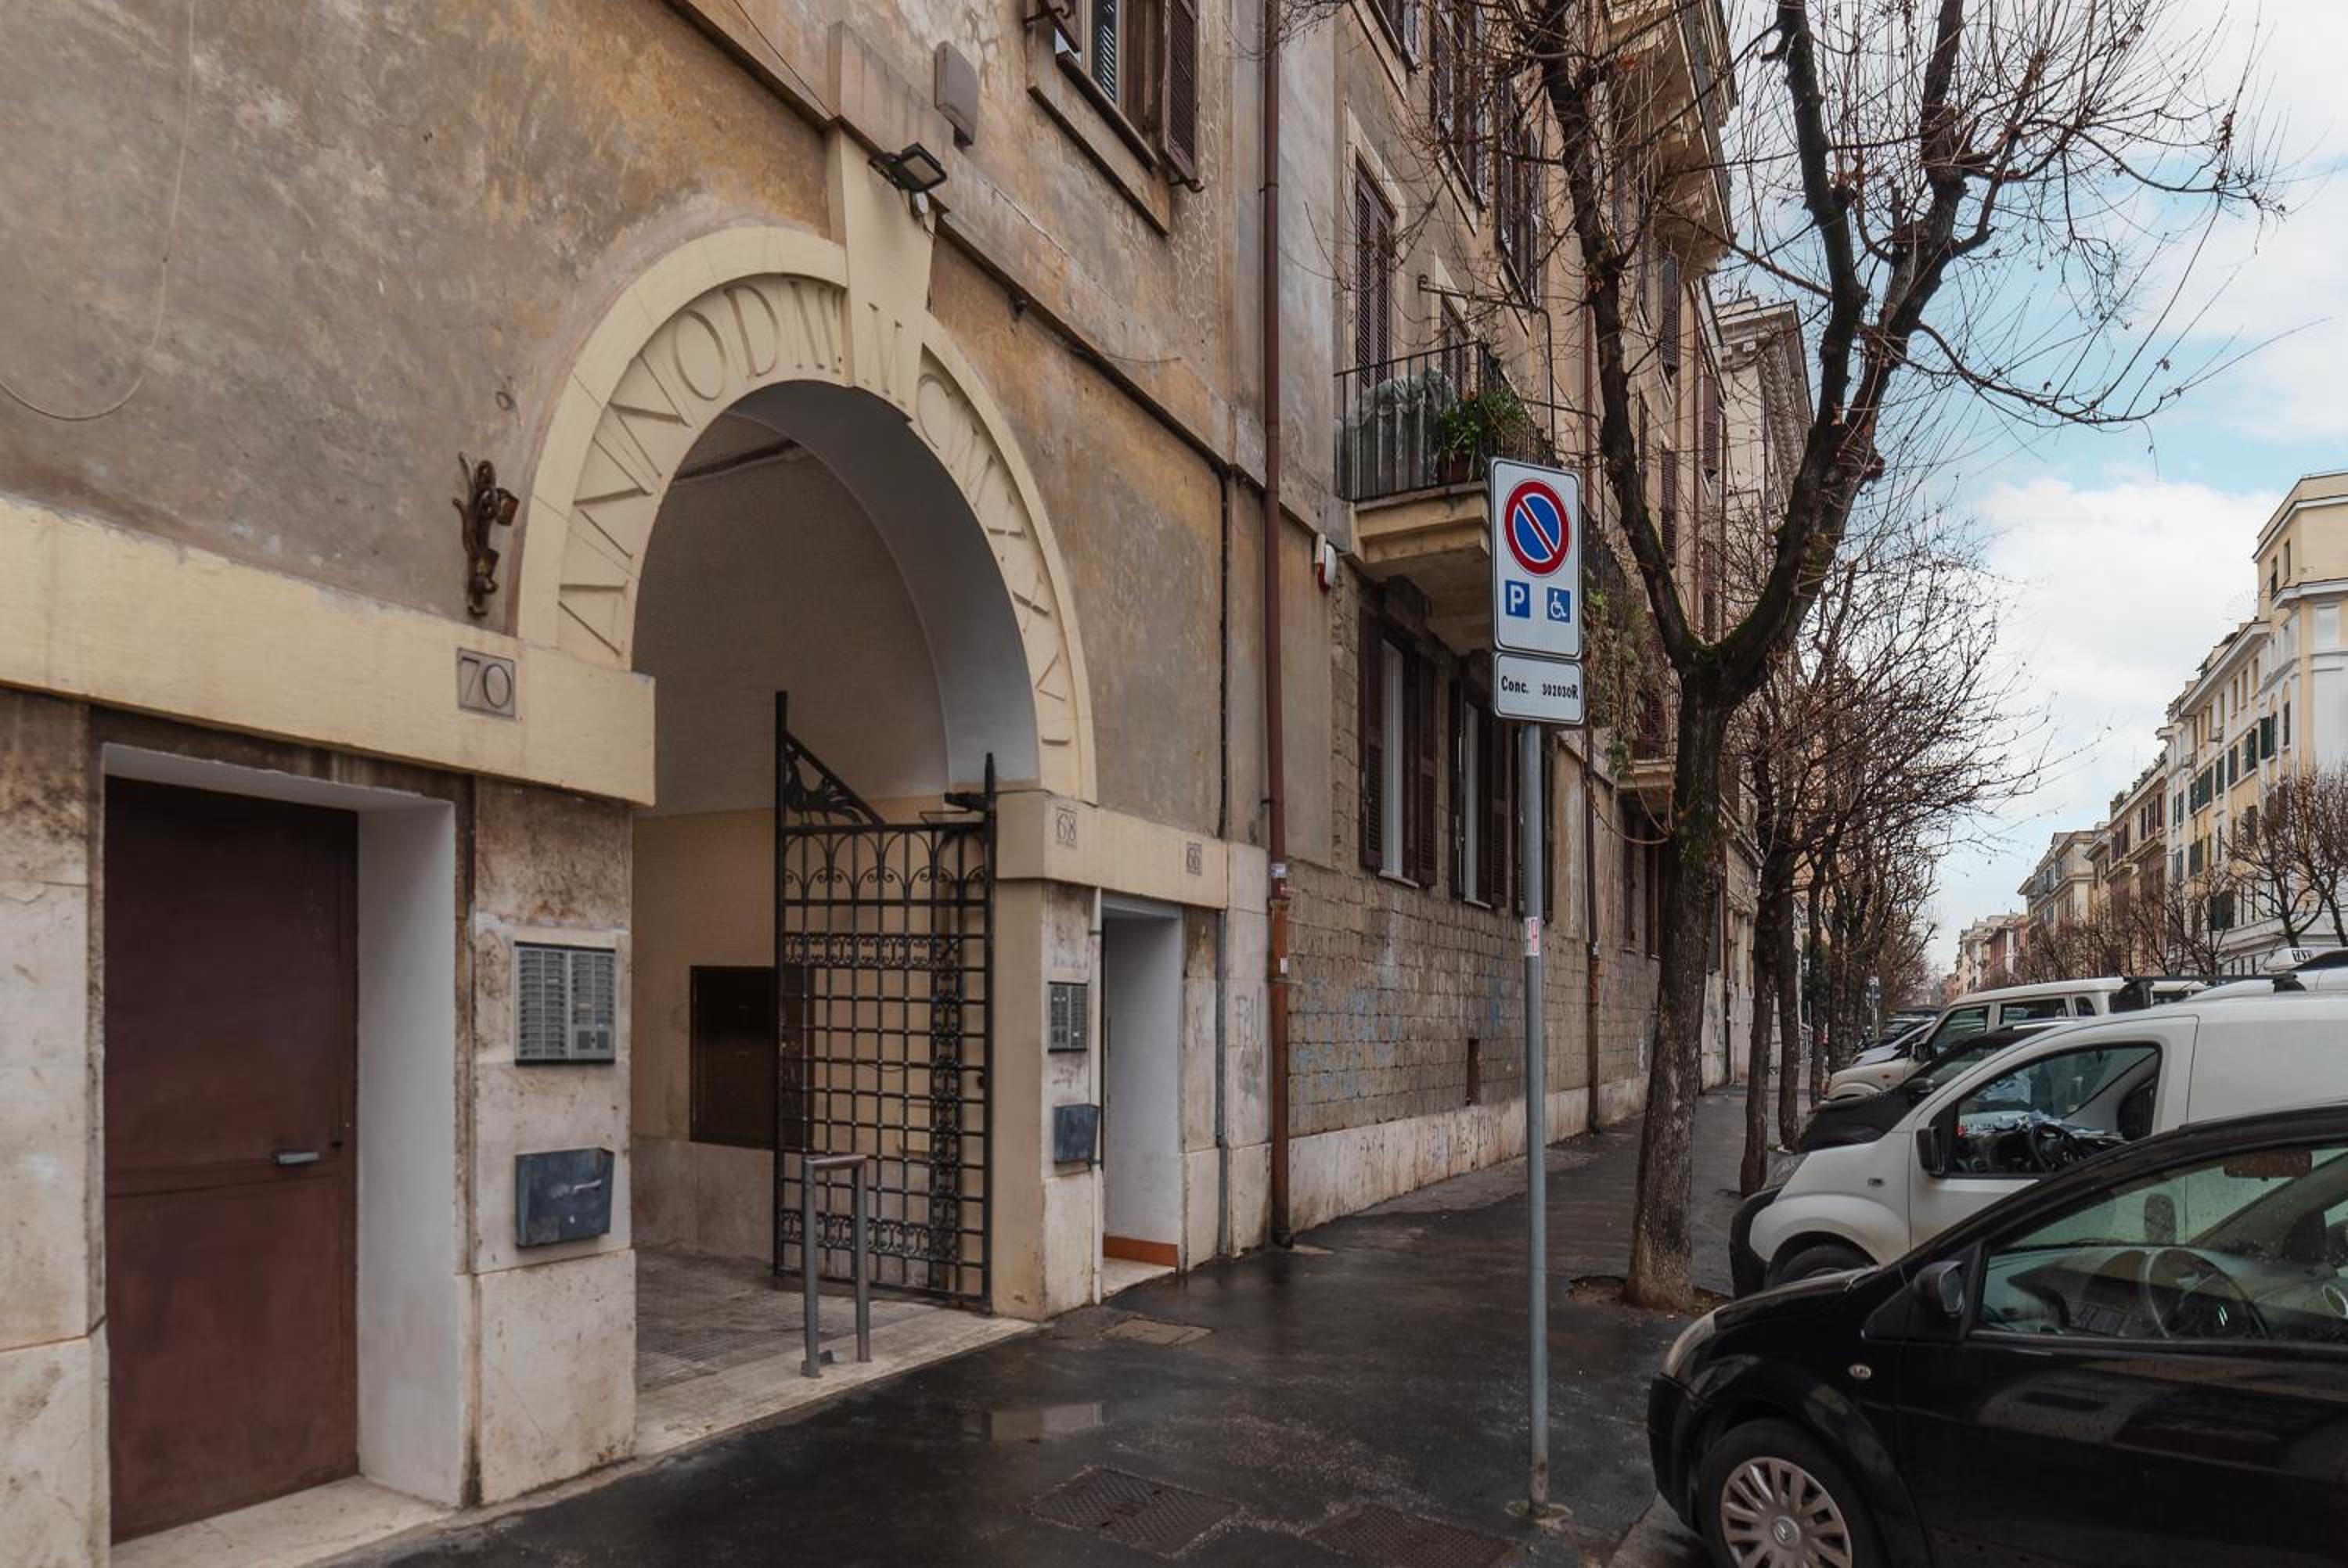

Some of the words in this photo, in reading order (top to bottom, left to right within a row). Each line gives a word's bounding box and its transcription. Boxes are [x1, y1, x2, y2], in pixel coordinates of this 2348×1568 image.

[1510, 584, 1525, 613] P
[461, 656, 513, 709] 70
[1500, 675, 1529, 694] Conc.
[1057, 813, 1076, 842] 68
